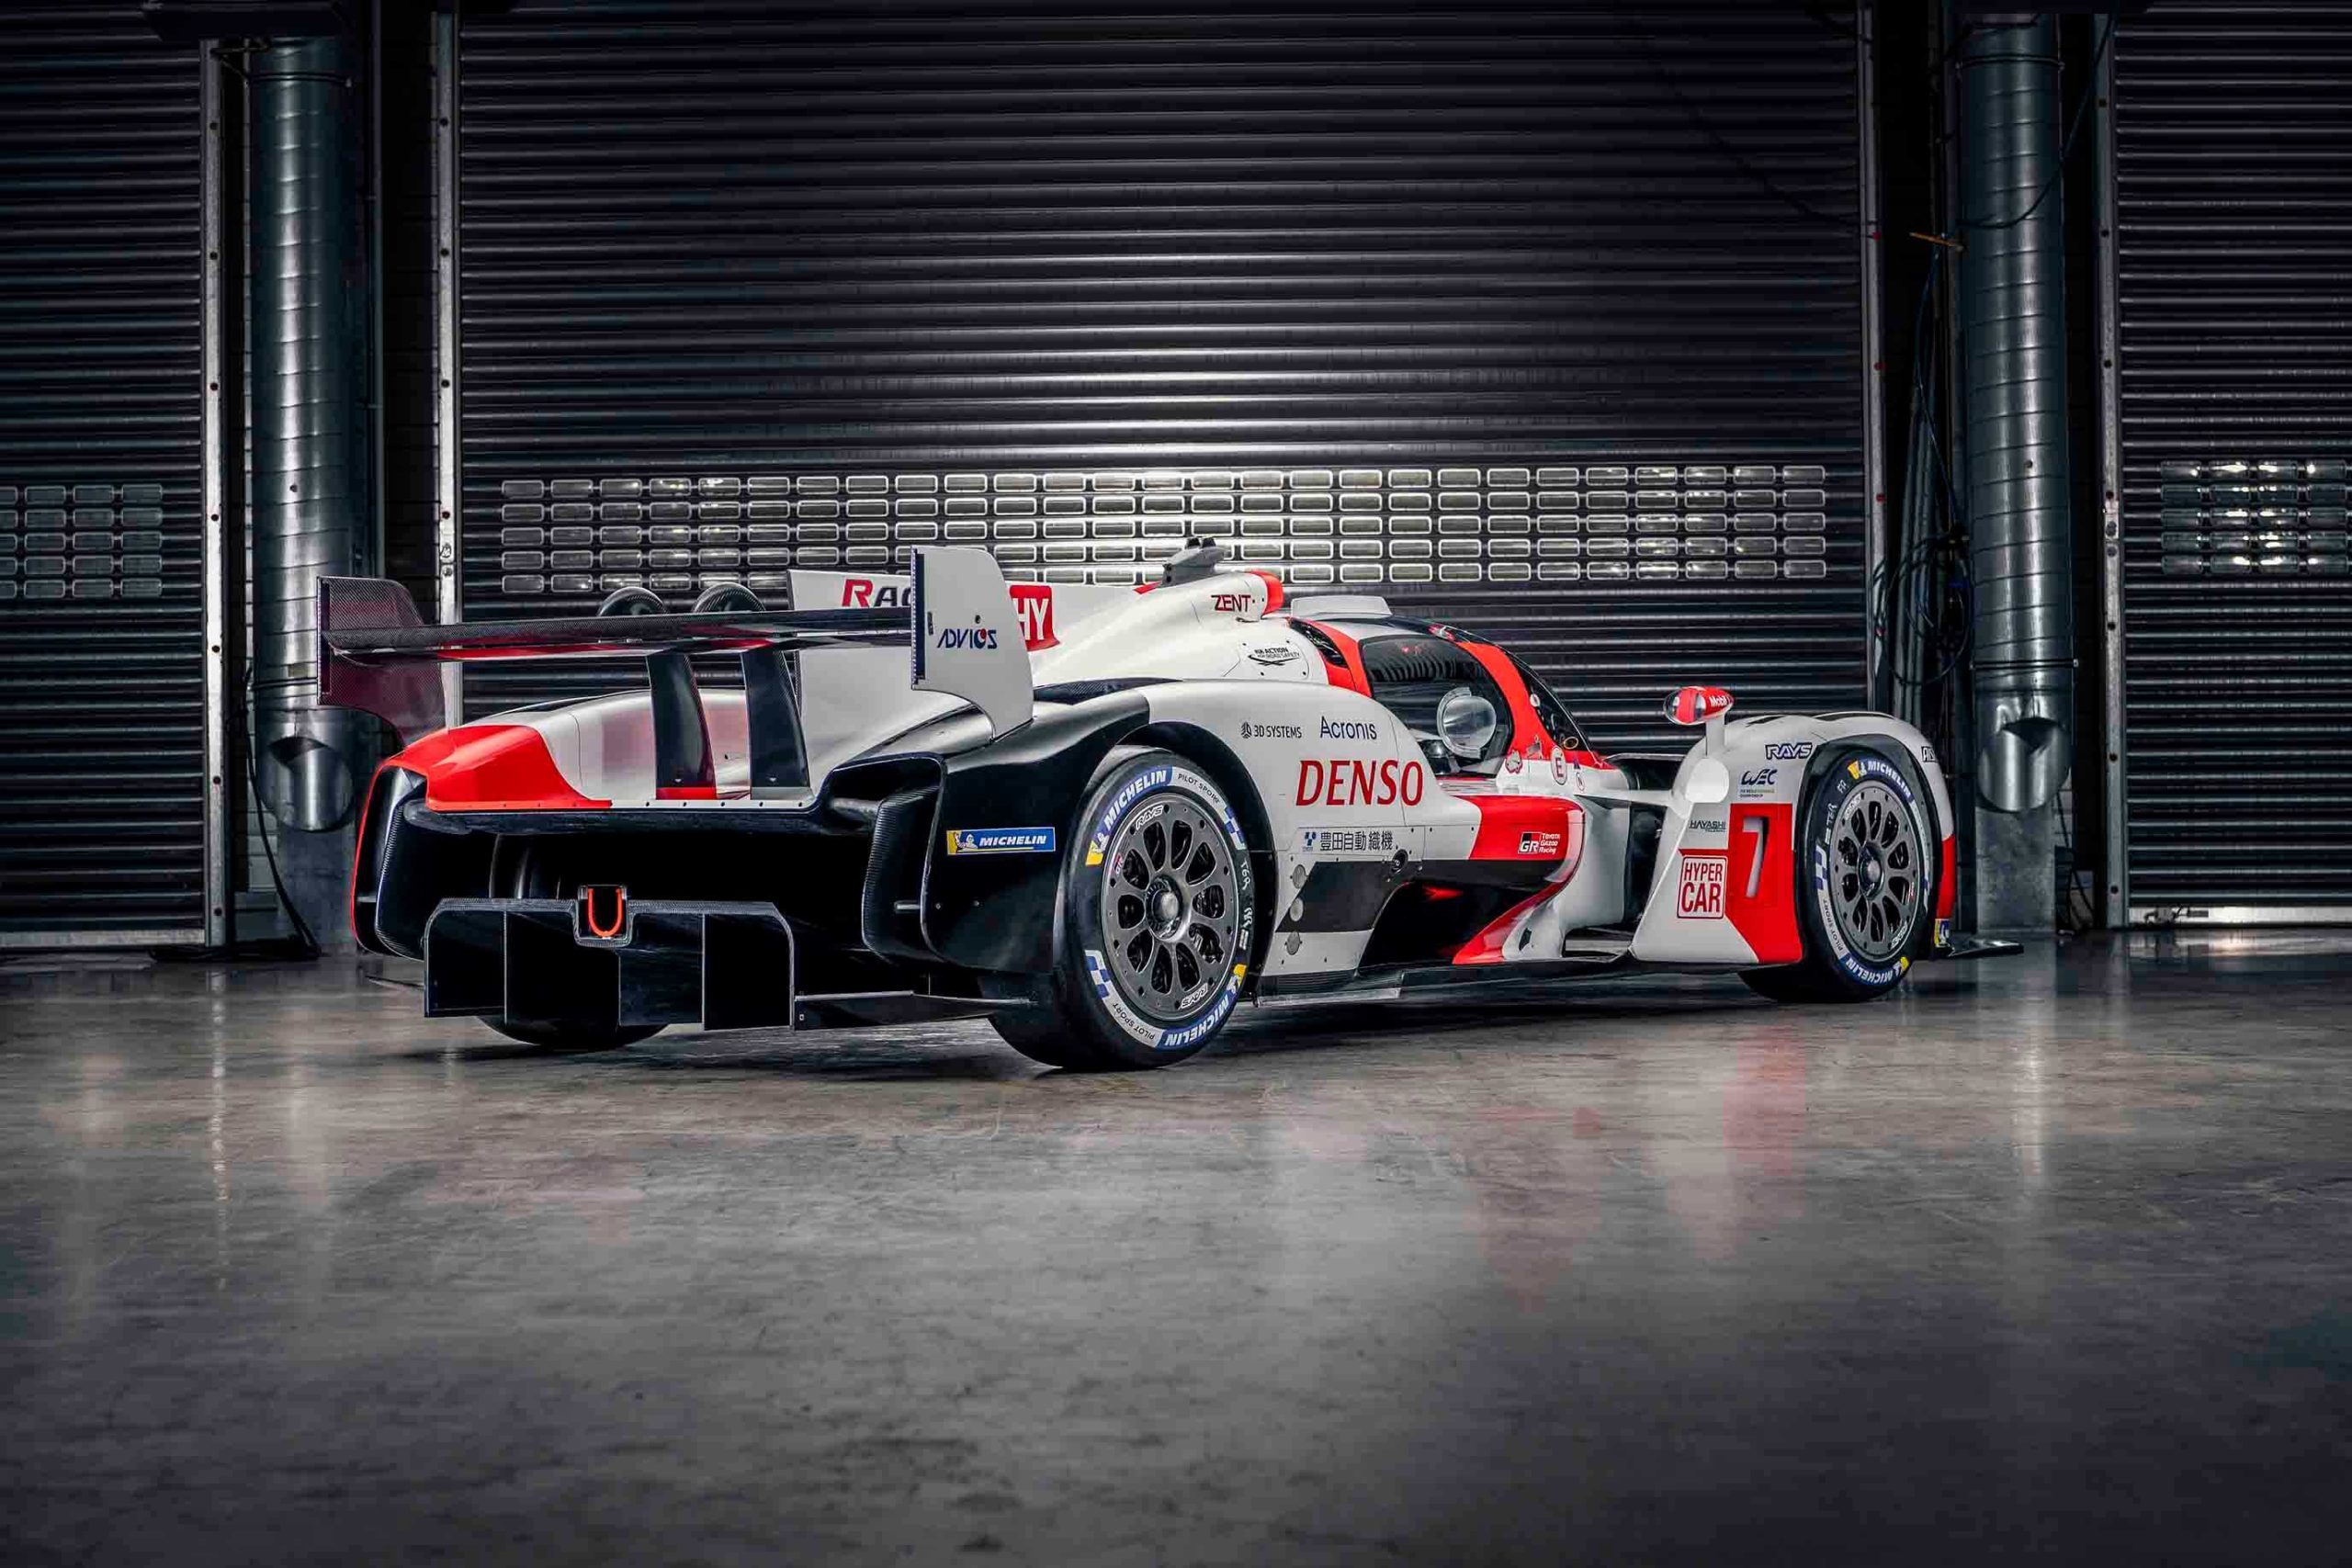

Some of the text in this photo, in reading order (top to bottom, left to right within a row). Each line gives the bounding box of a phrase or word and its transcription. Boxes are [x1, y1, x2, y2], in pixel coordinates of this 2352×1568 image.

[1211, 593, 1251, 613] ZENT
[937, 627, 998, 649] ADVICS
[1254, 725, 1303, 739] 3D SYSTEMS
[1319, 716, 1377, 740] Acronis
[1765, 742, 1813, 761] RAYS
[1178, 773, 1221, 805] PILOT SPORT
[1295, 759, 1424, 807] DENSO
[1740, 768, 1778, 785] WEC
[1867, 760, 1912, 798] MICHELIN
[1103, 769, 1168, 830] MICHELIN
[1134, 804, 1164, 831] RAYS
[1689, 819, 1726, 830] HAYASHI
[978, 835, 1047, 847] MICHELIN
[1320, 830, 1394, 852] 豊田自動織機
[1519, 840, 1540, 852] GR
[1742, 817, 1768, 898] 7
[1683, 863, 1724, 882] HYPER
[1680, 882, 1722, 913] CAR
[1845, 957, 1894, 984] MICHELIN
[1180, 982, 1209, 1010] RAYS
[1113, 1002, 1156, 1040] PILOT SPORT
[1164, 994, 1230, 1047] MICHELIN
